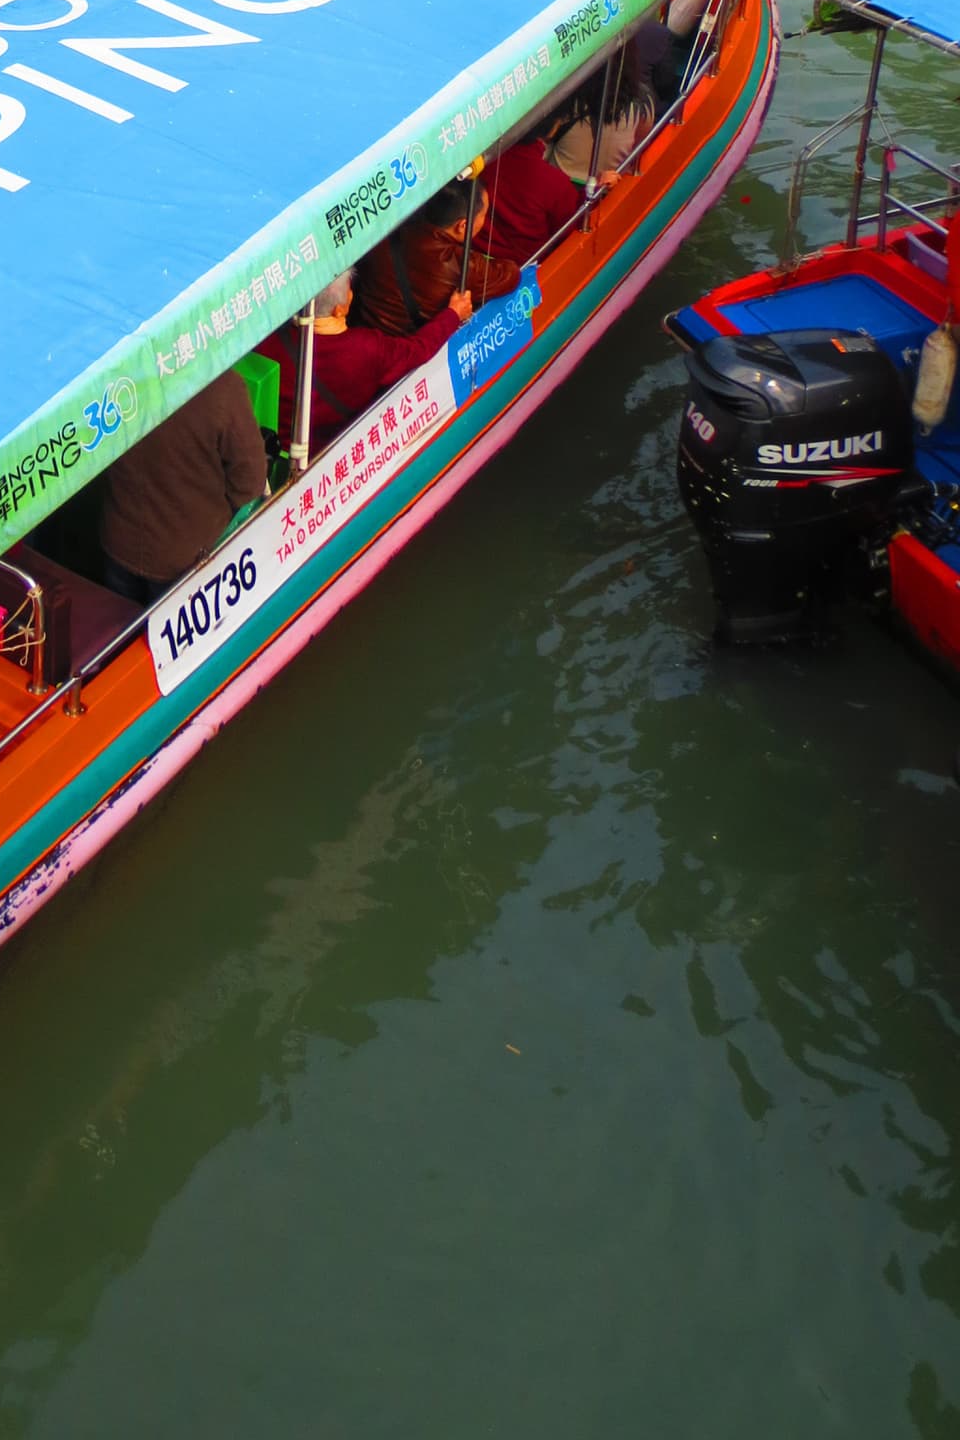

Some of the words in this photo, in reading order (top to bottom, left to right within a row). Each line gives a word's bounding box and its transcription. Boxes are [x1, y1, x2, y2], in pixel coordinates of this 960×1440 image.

[565, 0, 599, 31] NGONG
[569, 14, 601, 52] PING
[439, 45, 551, 153] 大澳小艇遊有限公司
[339, 170, 387, 216] NGONG
[344, 187, 392, 239] PING
[156, 233, 320, 379] 大澳小艇遊有限公司
[468, 311, 503, 350] NGONG
[470, 327, 506, 364] PING
[7, 421, 77, 486] NGONG
[11, 441, 82, 512] PING
[280, 378, 429, 536] 大澳小艇遊有限公司
[757, 430, 883, 465] SUZUKI
[276, 538, 295, 564] TAI
[296, 528, 306, 545] O
[307, 496, 337, 535] BOAT
[339, 438, 400, 505] EXCURSION
[400, 401, 439, 446] LIMITED
[160, 547, 257, 661] 140736
